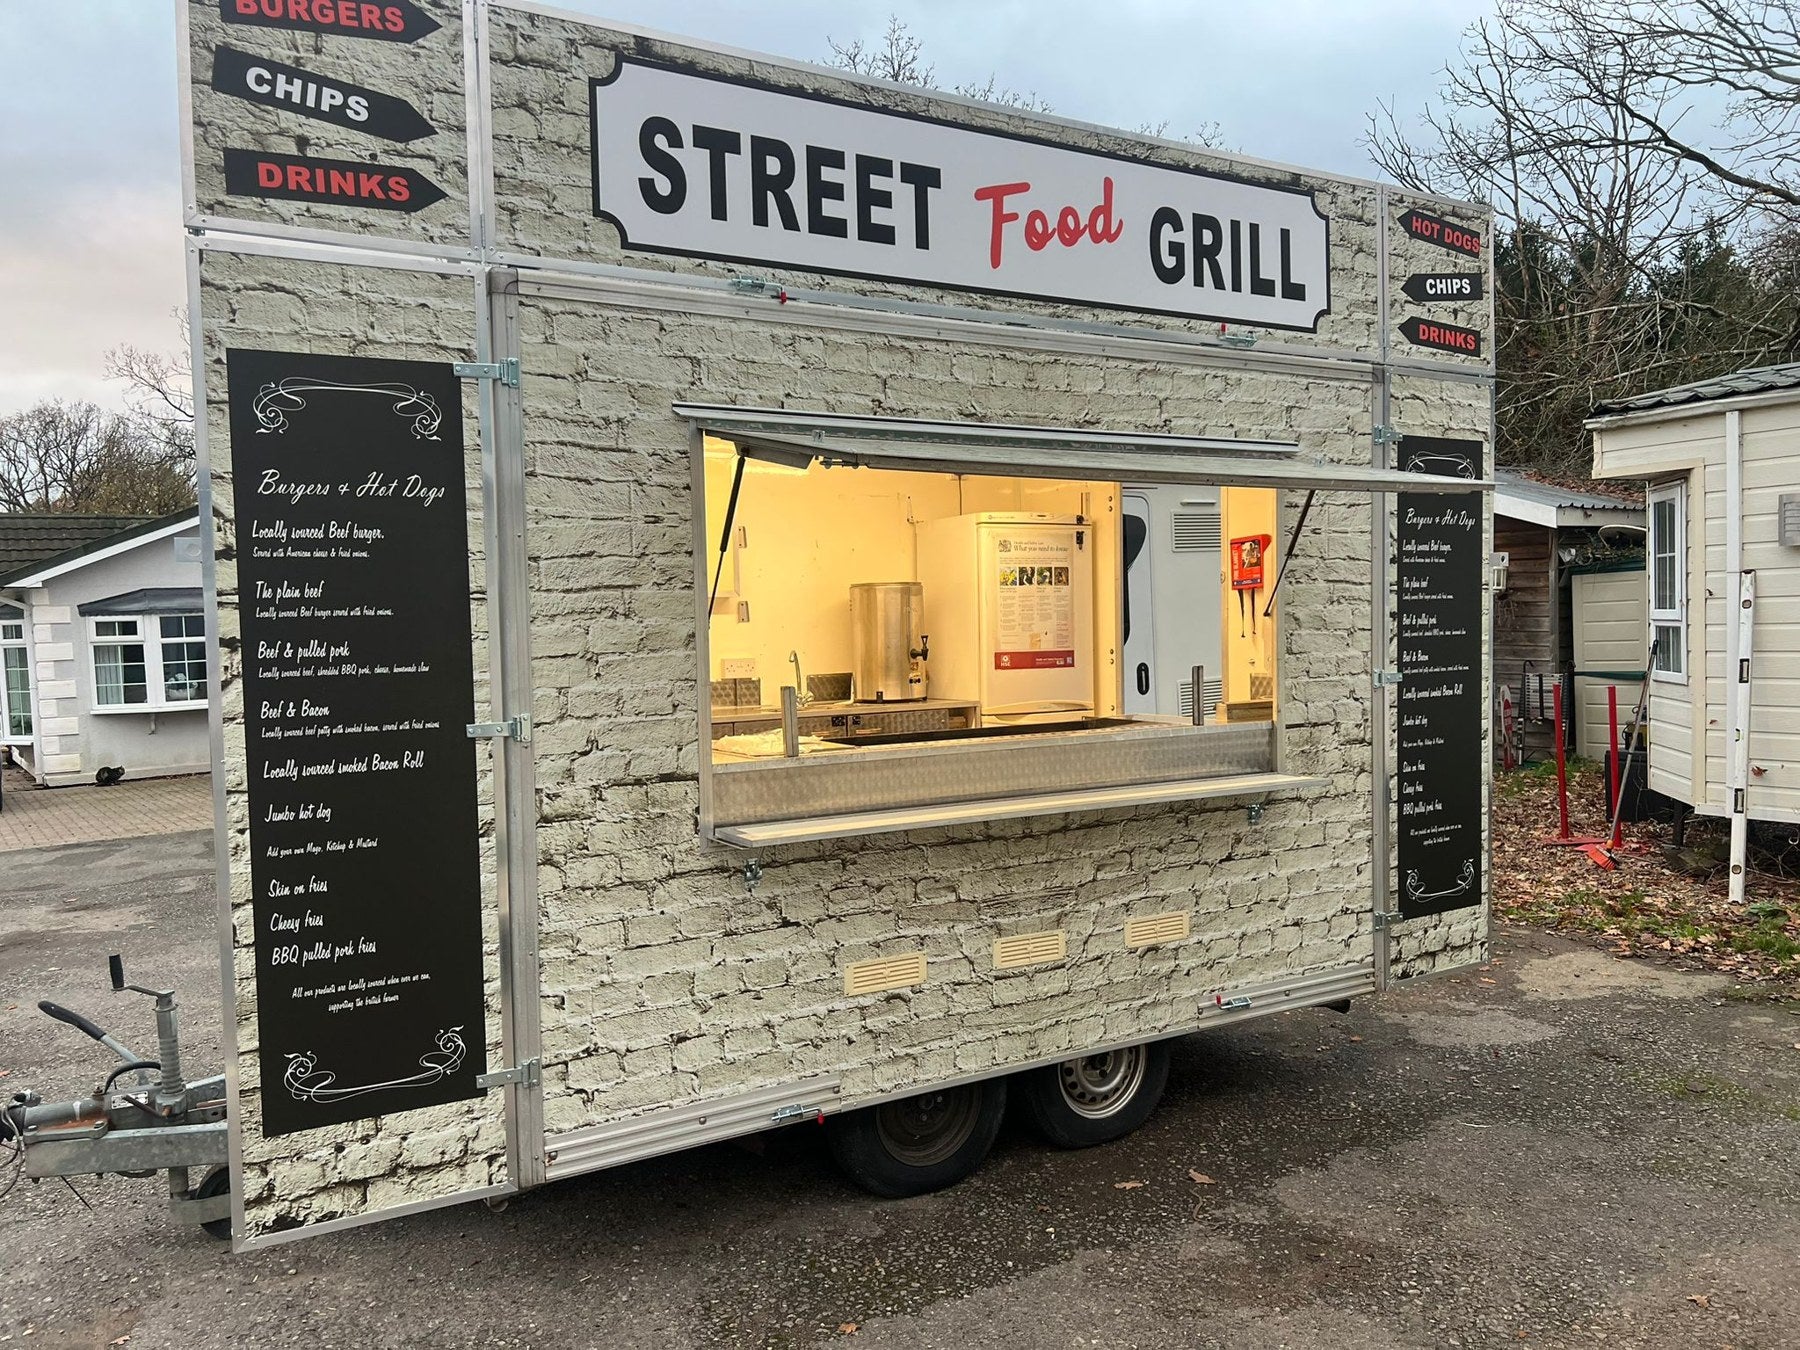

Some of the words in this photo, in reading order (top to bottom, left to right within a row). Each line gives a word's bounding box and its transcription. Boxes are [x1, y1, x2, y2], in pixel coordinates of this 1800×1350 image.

[235, 0, 405, 33] BURGERS
[245, 66, 369, 122] CHIPS
[257, 162, 410, 202] DRINKS
[637, 115, 942, 251] STREET
[974, 176, 1124, 270] Food
[1150, 206, 1306, 303] GRILL
[1412, 216, 1441, 239] HOT
[1444, 227, 1480, 253] DOGS
[1426, 278, 1471, 295] CHIPS
[1419, 324, 1476, 350] DRINKS
[257, 469, 330, 504] Burgers
[355, 471, 399, 497] Hot
[402, 474, 445, 507] Dogs
[252, 519, 287, 542] Locally
[291, 523, 325, 539] sourced
[329, 520, 351, 539] Beef
[353, 523, 384, 544] burger.
[330, 548, 336, 558] &
[256, 581, 273, 599] The
[276, 580, 300, 604] plain
[304, 580, 325, 598] beef
[258, 641, 281, 659] Beef
[283, 642, 293, 658] &
[297, 639, 327, 663] pulled
[329, 641, 350, 662] pork
[341, 664, 357, 675] BBQ
[261, 700, 284, 719] Beef
[286, 702, 296, 717] &
[301, 699, 330, 717] Bacon
[263, 759, 298, 781] Locally
[302, 758, 334, 777] sourced
[338, 755, 367, 774] smoked
[372, 753, 399, 771] Bacon
[403, 750, 425, 768] Roll
[264, 804, 296, 823] Jumbo
[299, 803, 315, 820] hot
[317, 803, 332, 823] dog
[268, 879, 290, 898] Skin
[294, 884, 305, 895] on
[309, 875, 328, 893] fries
[270, 913, 300, 933] Cheesy
[304, 910, 324, 928] fries
[272, 945, 299, 966] BBQ
[302, 942, 331, 967] pulled
[334, 940, 355, 963] pork
[358, 937, 376, 954] fries
